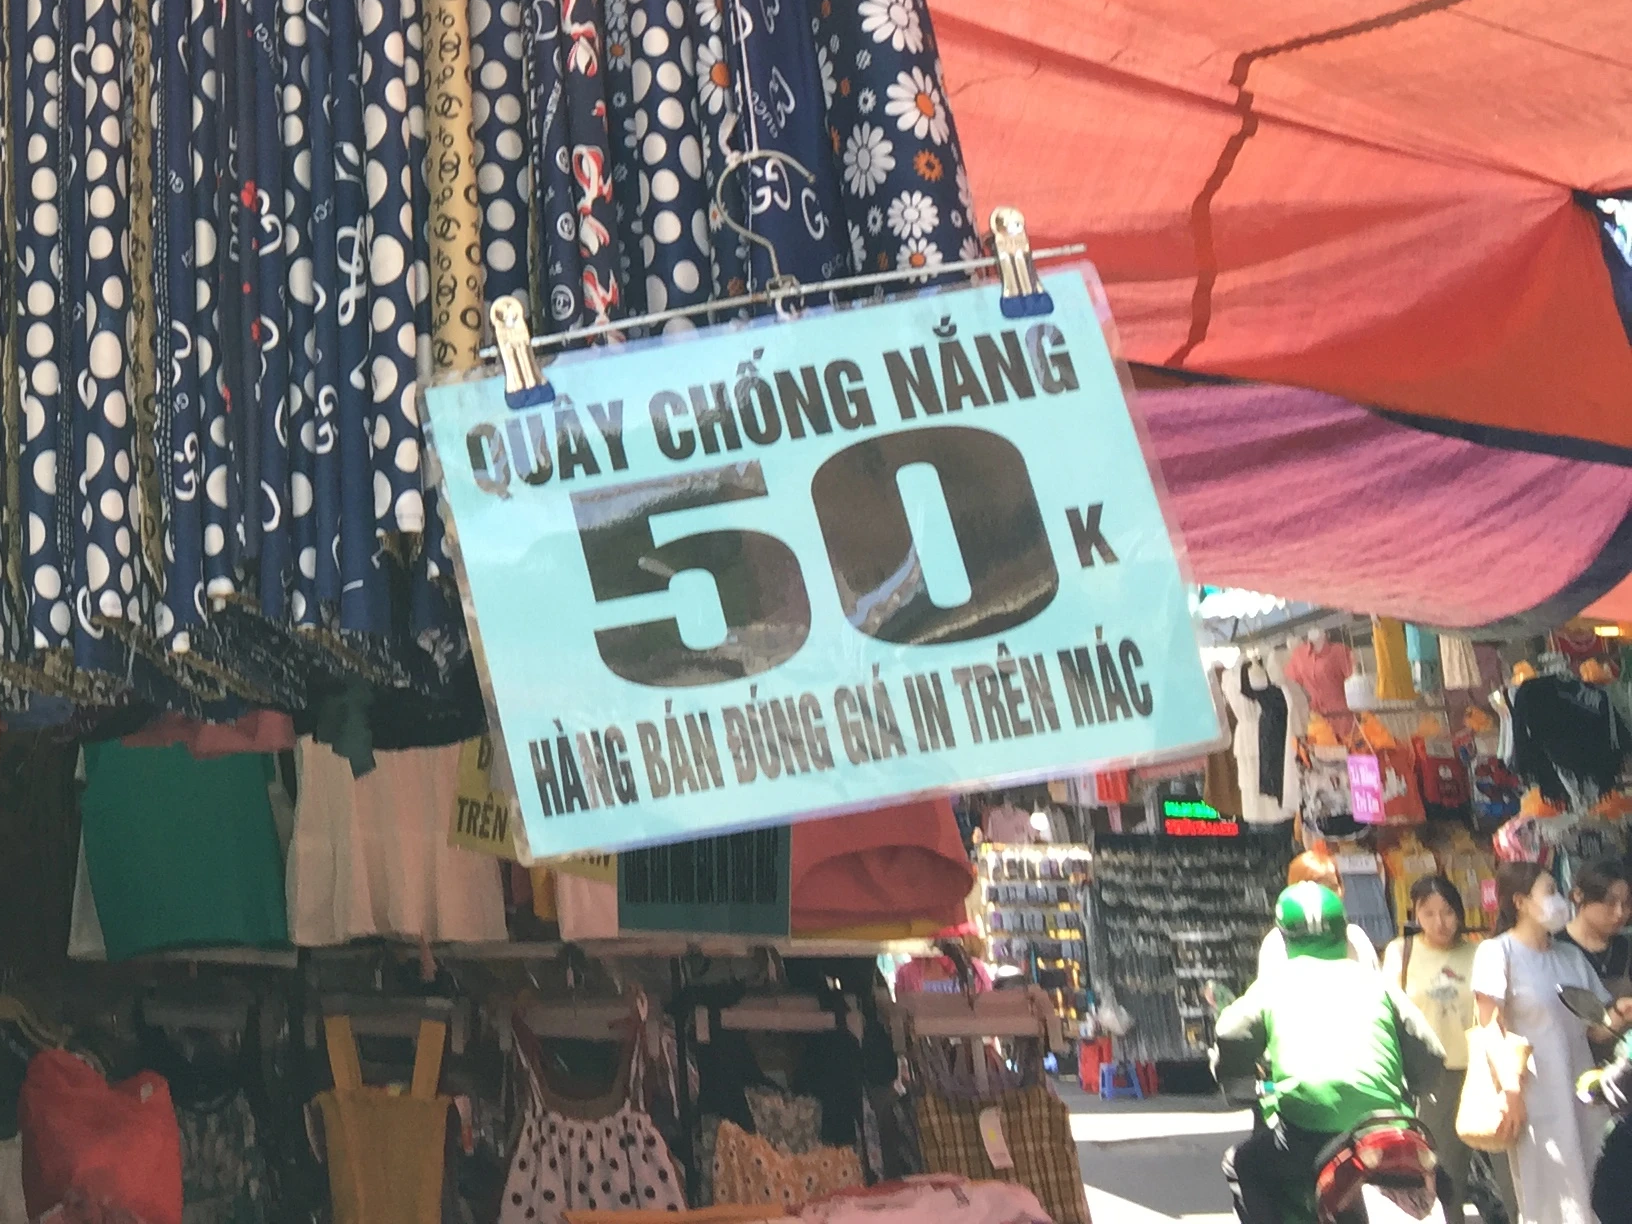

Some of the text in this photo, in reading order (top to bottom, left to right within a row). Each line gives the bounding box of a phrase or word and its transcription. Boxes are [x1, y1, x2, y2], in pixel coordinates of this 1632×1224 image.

[649, 347, 876, 460] CHỐNG
[883, 316, 1079, 420] NẮNG
[529, 626, 1152, 817] HÀNG BÁN ĐÚNG GIÁ IN TRÊN MÁC
[457, 793, 509, 843] TRÊN
